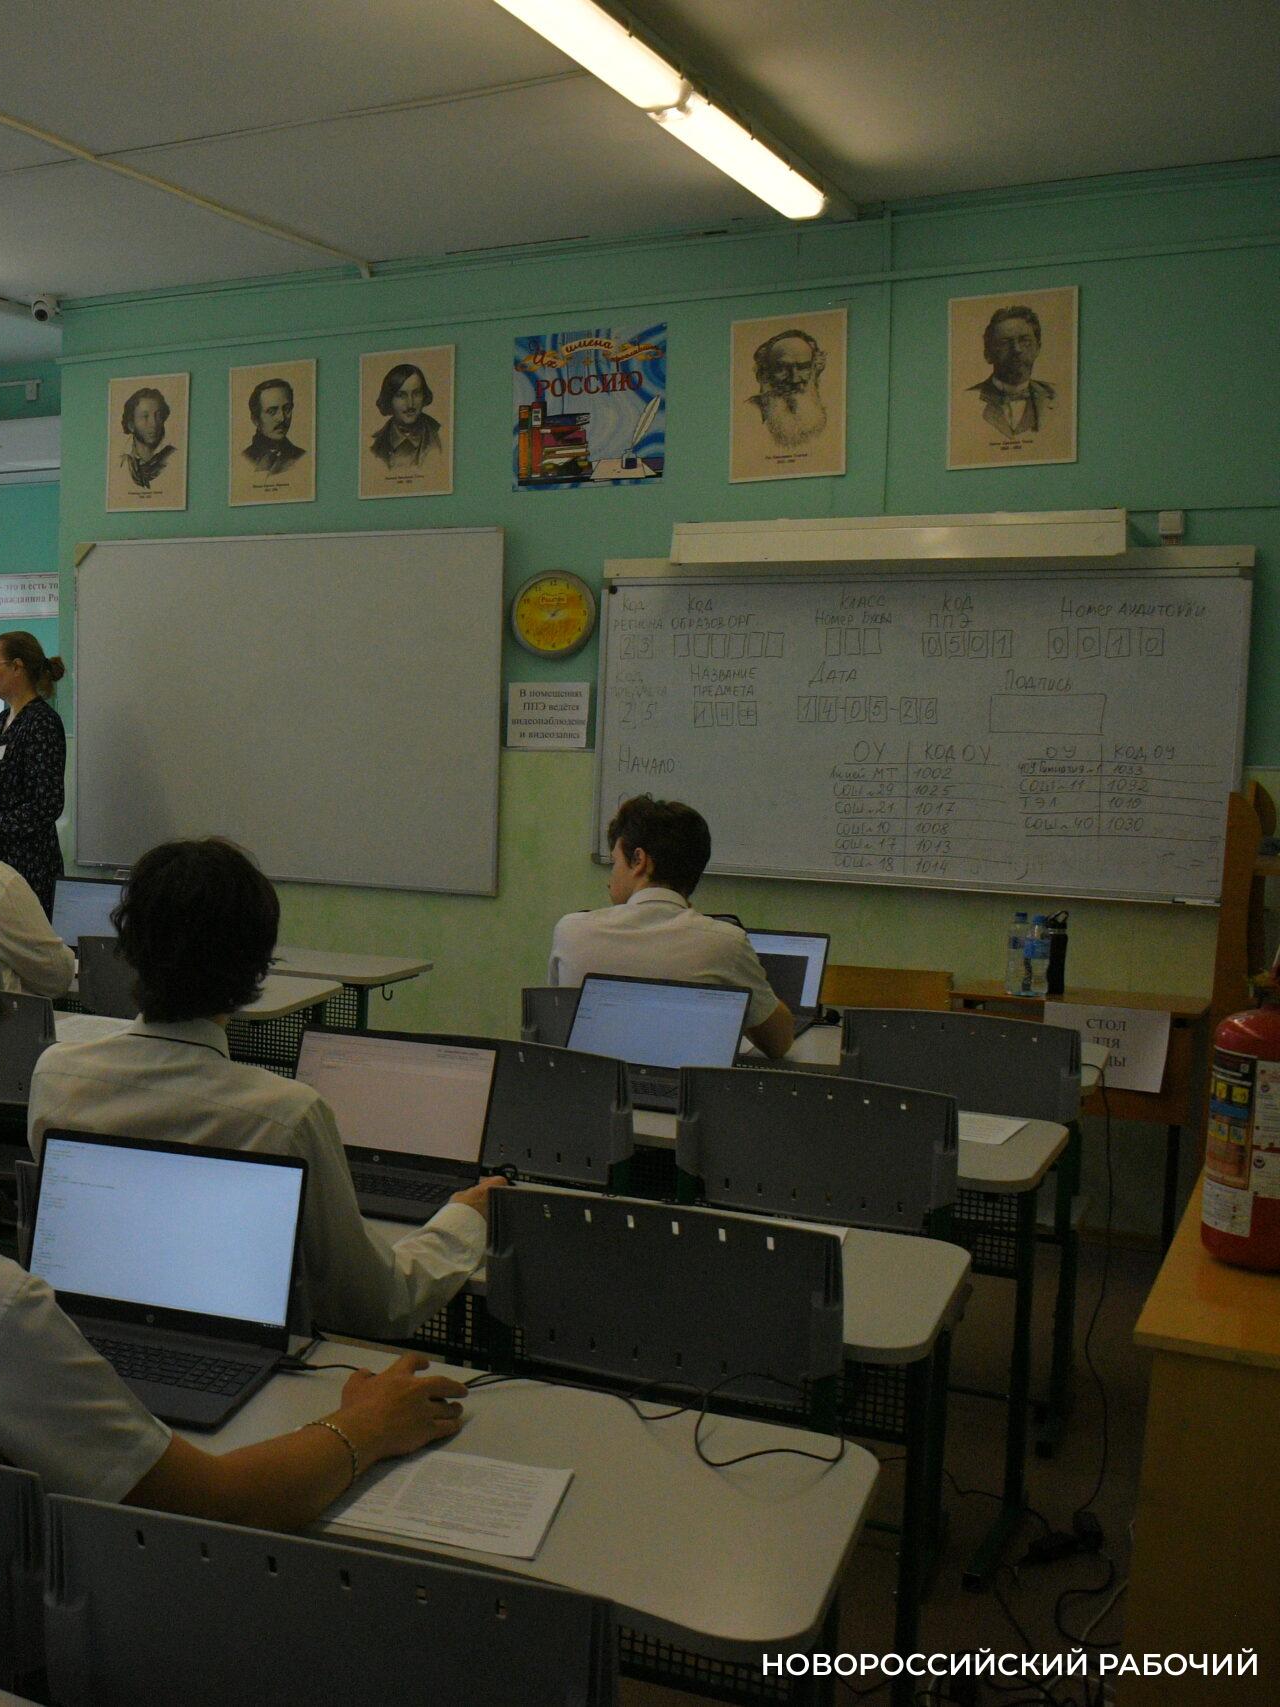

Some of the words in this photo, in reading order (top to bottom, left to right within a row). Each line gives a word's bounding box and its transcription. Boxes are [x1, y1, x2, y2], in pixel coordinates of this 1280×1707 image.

[535, 370, 643, 400] РОССИЮ
[523, 702, 546, 711] ППЭ
[1086, 1018, 1127, 1032] СТОЛ
